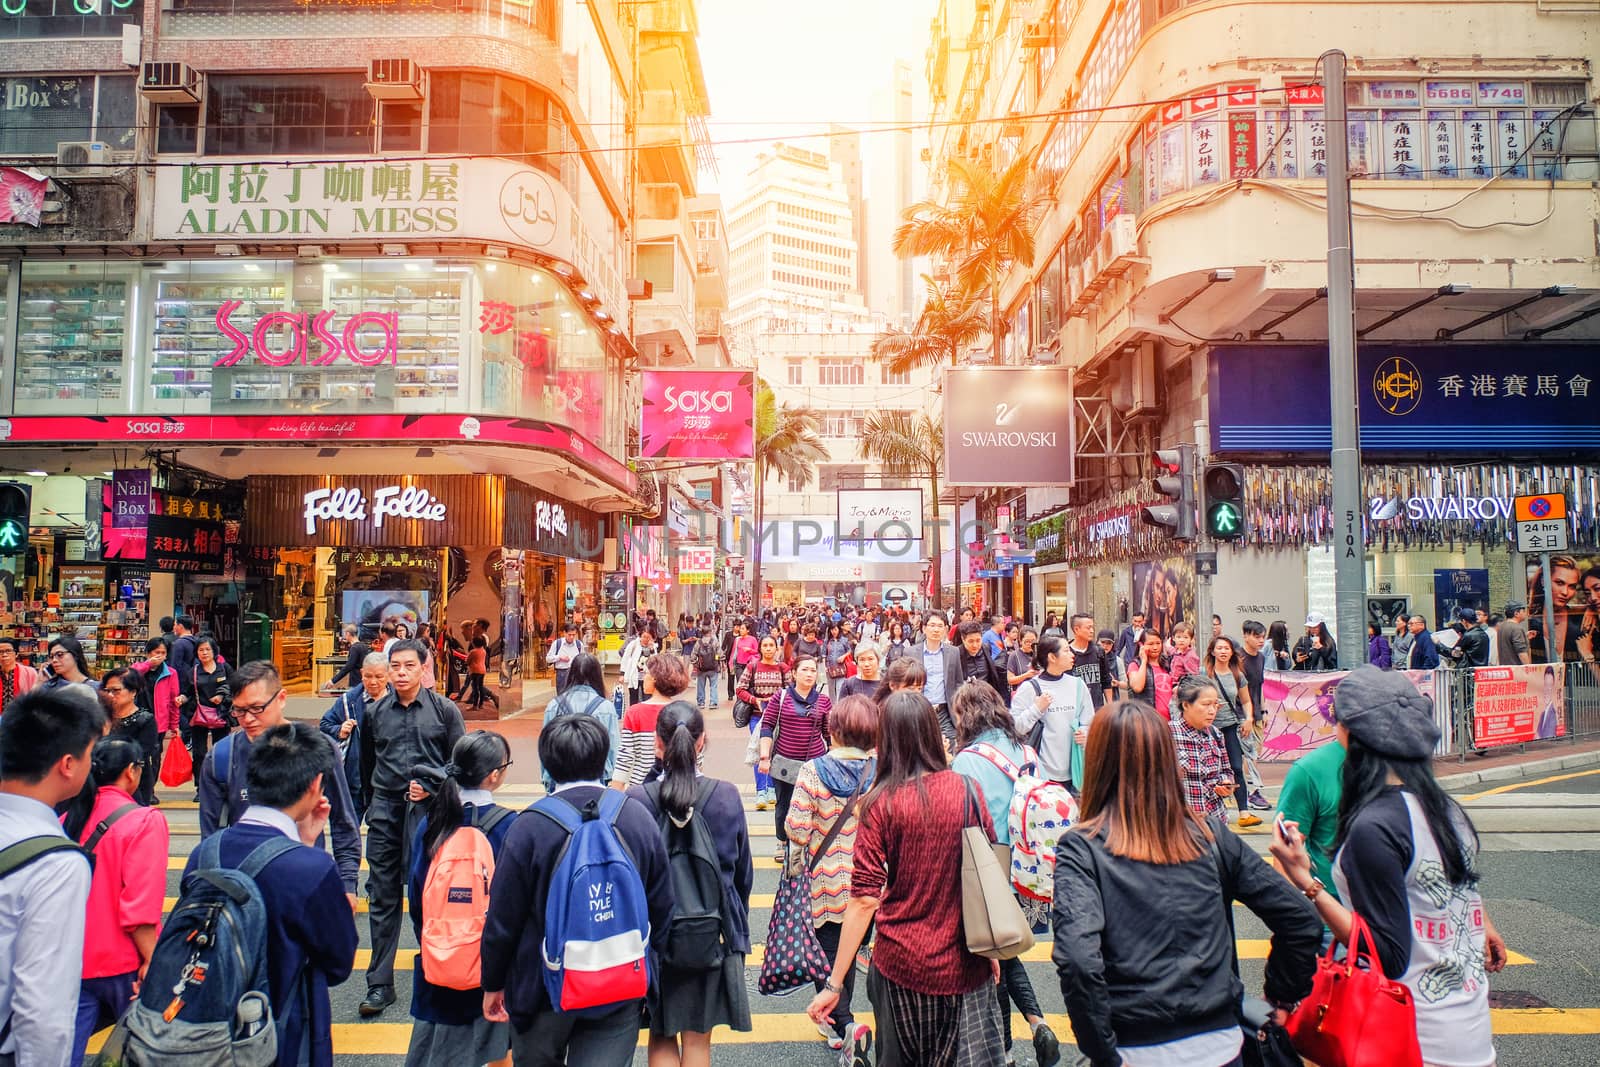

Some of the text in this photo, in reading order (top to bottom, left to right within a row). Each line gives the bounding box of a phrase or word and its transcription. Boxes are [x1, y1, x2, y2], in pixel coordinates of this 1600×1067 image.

[180, 162, 458, 203] 阿拉丁咖喱屋
[175, 207, 458, 234] ALADIN MESS
[213, 299, 398, 367] Sasa
[1437, 373, 1592, 398] 香港賽馬會
[664, 386, 733, 413] Sasa
[127, 421, 161, 434] Sasa
[163, 422, 185, 434] 莎莎
[268, 424, 298, 436] making
[317, 421, 356, 436] beautiful
[684, 415, 711, 430] 莎莎
[962, 432, 1057, 447] SWAROVSKI
[116, 480, 148, 496] Nail
[118, 500, 146, 515] Box
[304, 485, 446, 535] Folli Follie
[535, 500, 568, 542] Folli Follie
[1097, 515, 1130, 541] SWAROVSKI
[1524, 521, 1559, 533] 24 hrs
[1528, 534, 1558, 549] 全日
[1236, 605, 1280, 614] SWAROVSKI
